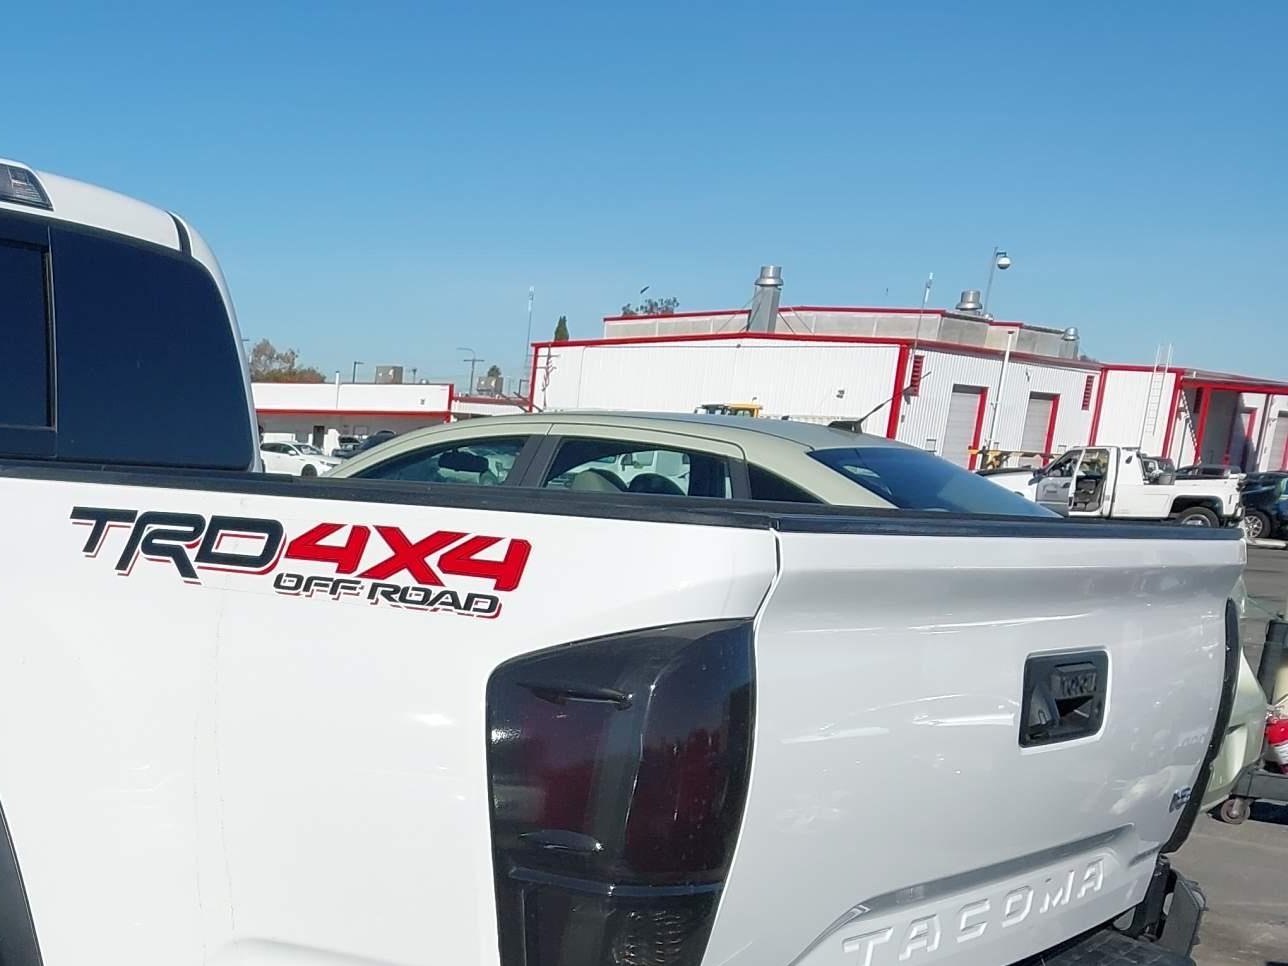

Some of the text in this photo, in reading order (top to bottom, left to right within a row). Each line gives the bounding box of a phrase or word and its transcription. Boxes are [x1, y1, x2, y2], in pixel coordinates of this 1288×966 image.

[69, 506, 287, 585] TRD
[273, 572, 502, 619] OFF ROAD
